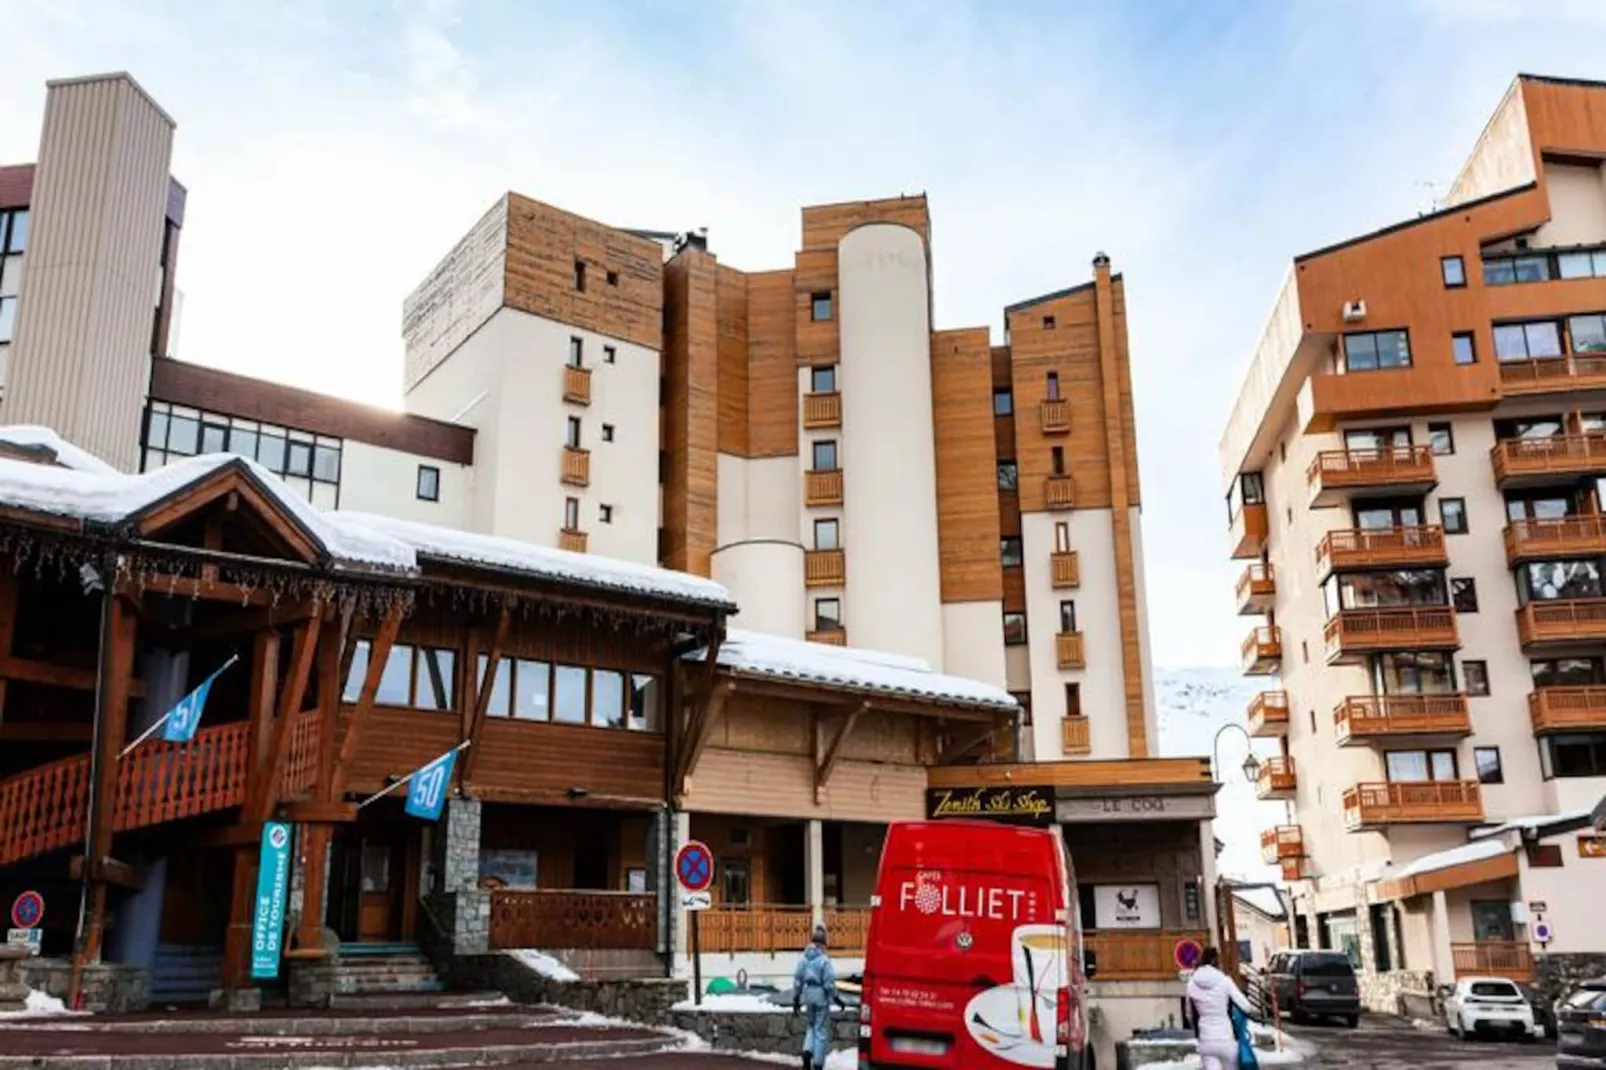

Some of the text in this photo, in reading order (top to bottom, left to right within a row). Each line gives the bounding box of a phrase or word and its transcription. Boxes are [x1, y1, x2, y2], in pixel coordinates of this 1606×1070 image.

[413, 765, 446, 809] 50
[932, 785, 1051, 819] Zenith Ski Shop
[1102, 798, 1165, 812] LE COQ
[267, 852, 287, 951] DE TOURISME
[900, 881, 1025, 920] FOLLIET
[256, 897, 270, 951] OFFICE
